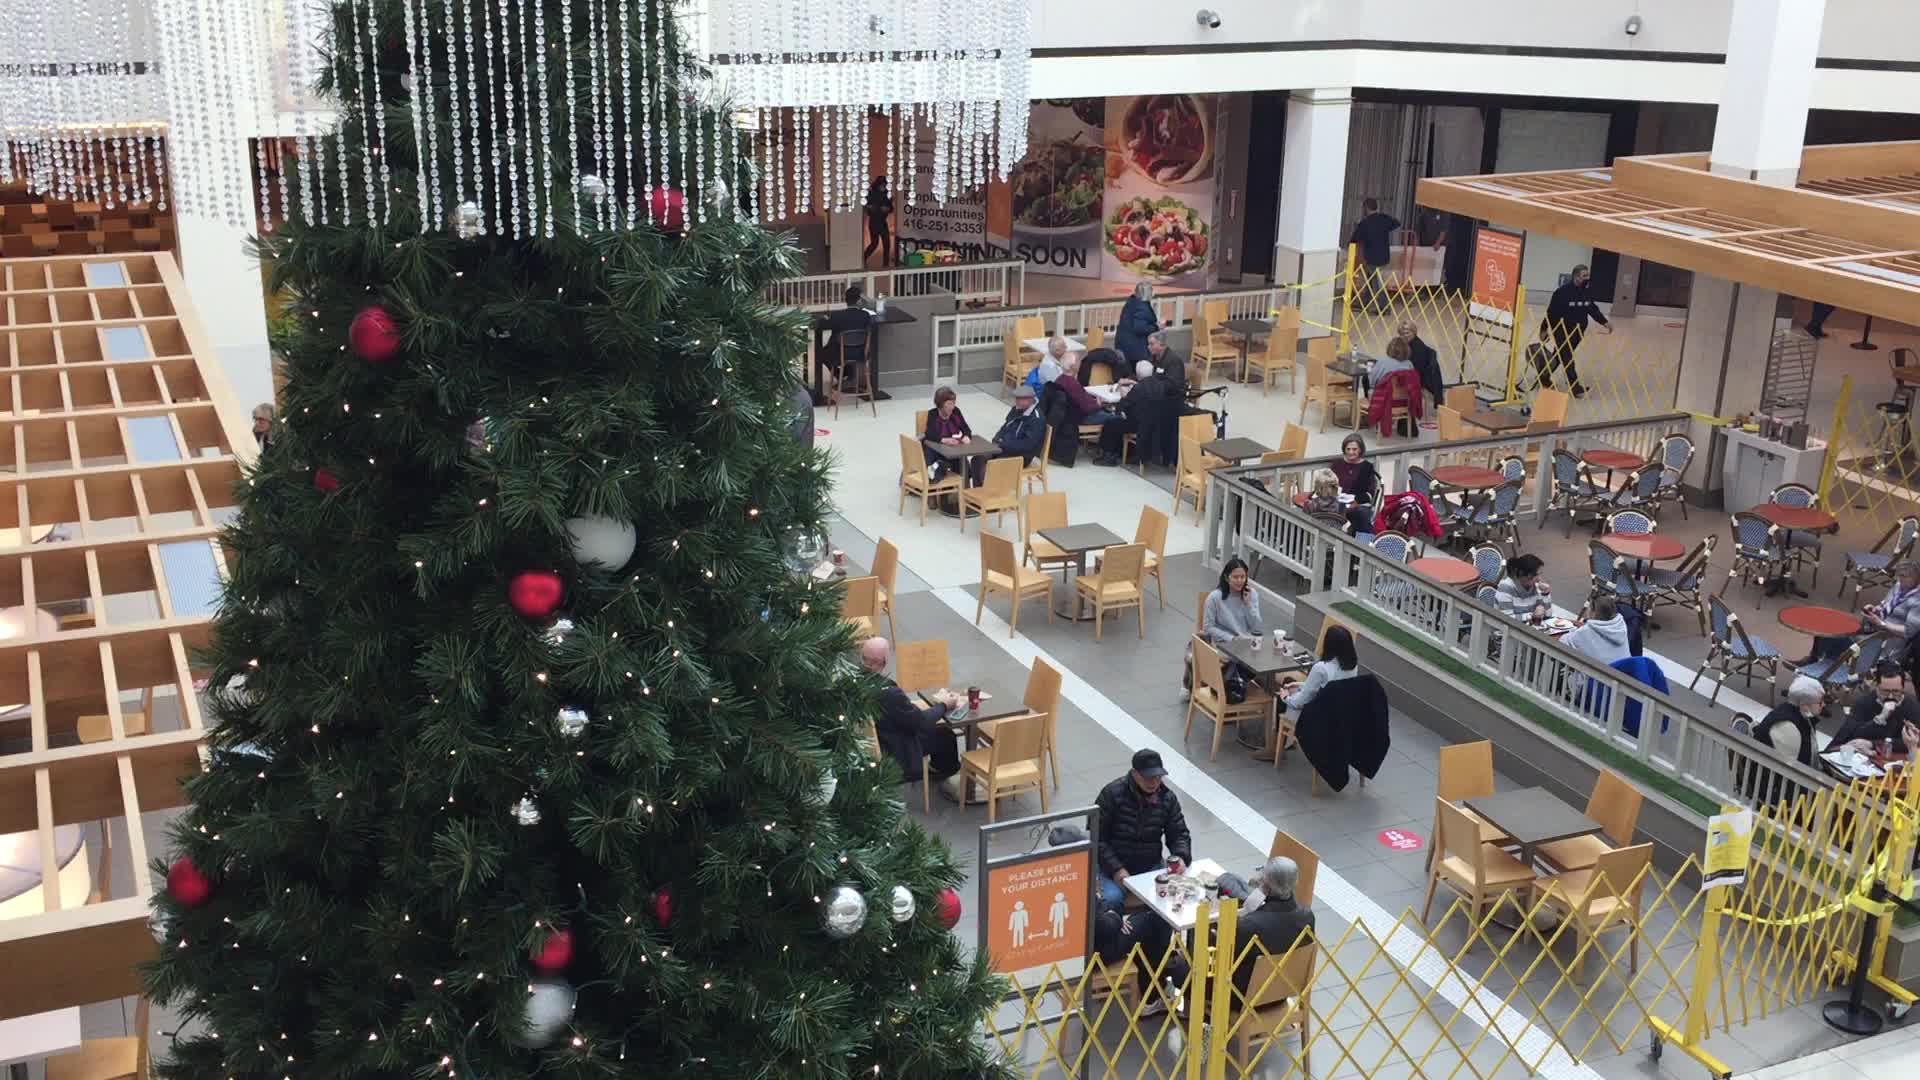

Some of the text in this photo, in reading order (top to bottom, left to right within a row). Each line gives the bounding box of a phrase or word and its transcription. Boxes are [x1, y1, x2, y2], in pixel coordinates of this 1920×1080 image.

[904, 204, 985, 220] Opportunities
[904, 219, 982, 234] 416-251-3353
[1016, 243, 1087, 268] SOON
[1008, 863, 1072, 882] PLEASE KEEP
[1001, 871, 1079, 895] YOUR DISTANCE
